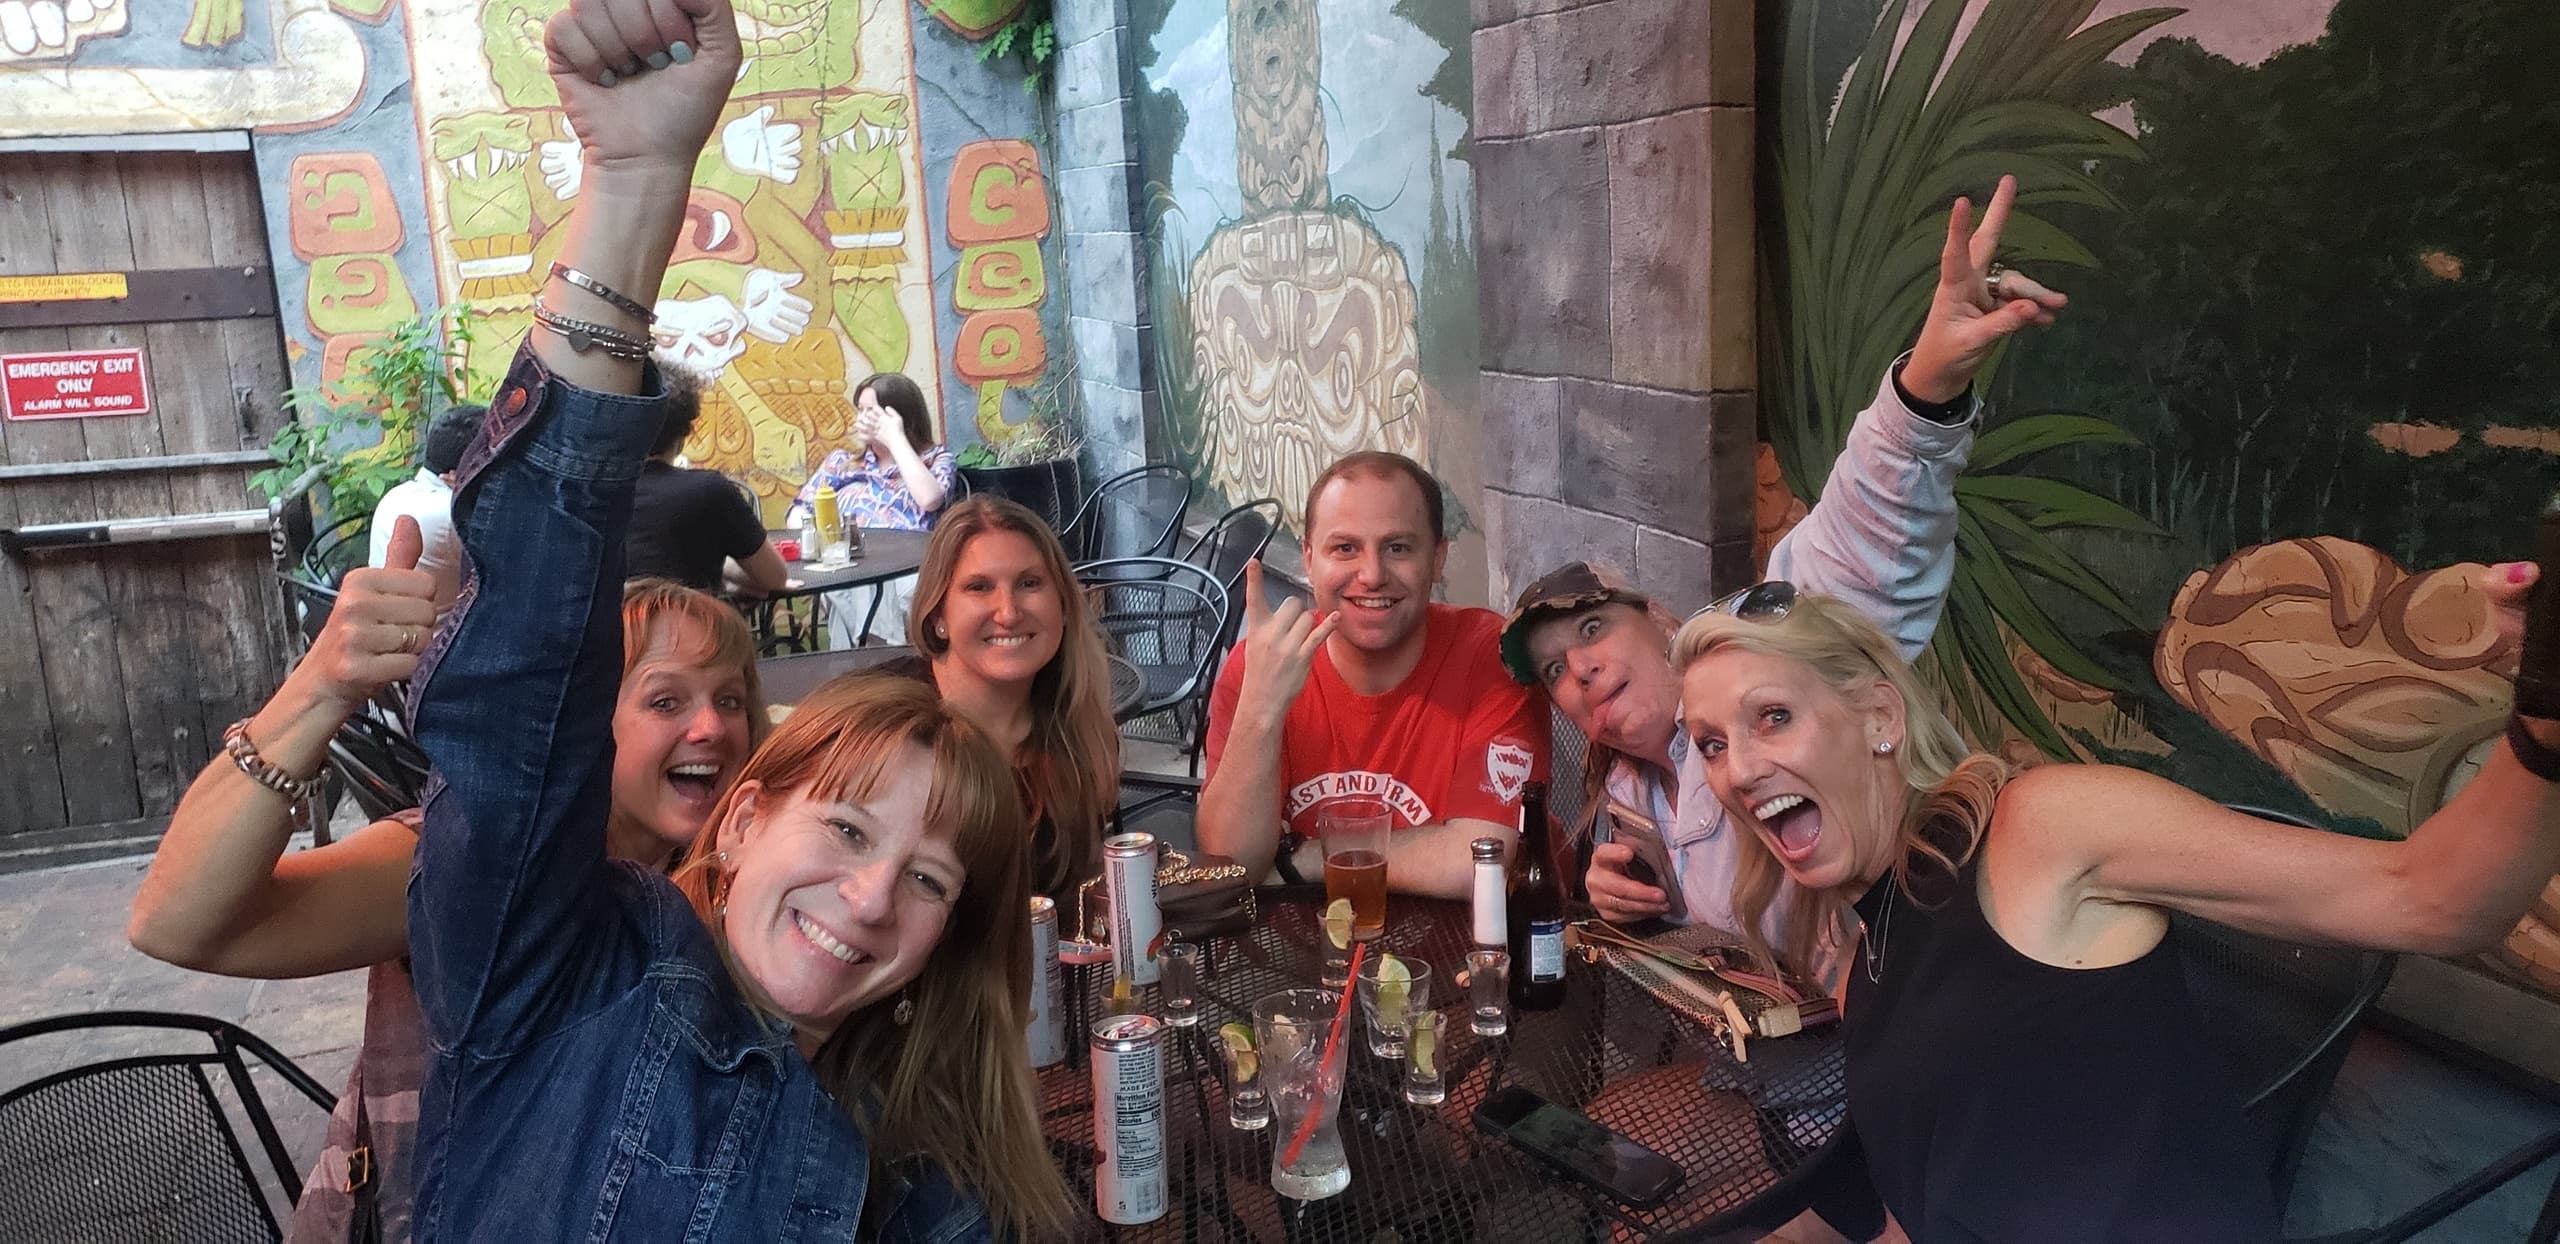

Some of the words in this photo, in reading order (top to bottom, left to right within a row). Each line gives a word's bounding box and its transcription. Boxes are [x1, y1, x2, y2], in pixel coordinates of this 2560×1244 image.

[24, 277, 64, 288] REMAIN
[67, 274, 124, 286] UNLOCKED
[27, 287, 91, 297] OCCUPANCY
[9, 360, 98, 378] EMERGENCY
[103, 358, 135, 374] EXIT
[56, 378, 93, 393] ONLY
[24, 398, 62, 411] ALARM
[65, 397, 90, 409] WILL
[94, 395, 133, 407] SOUND
[1335, 774, 1377, 794] AND
[1116, 1094, 1146, 1102] Nutrition
